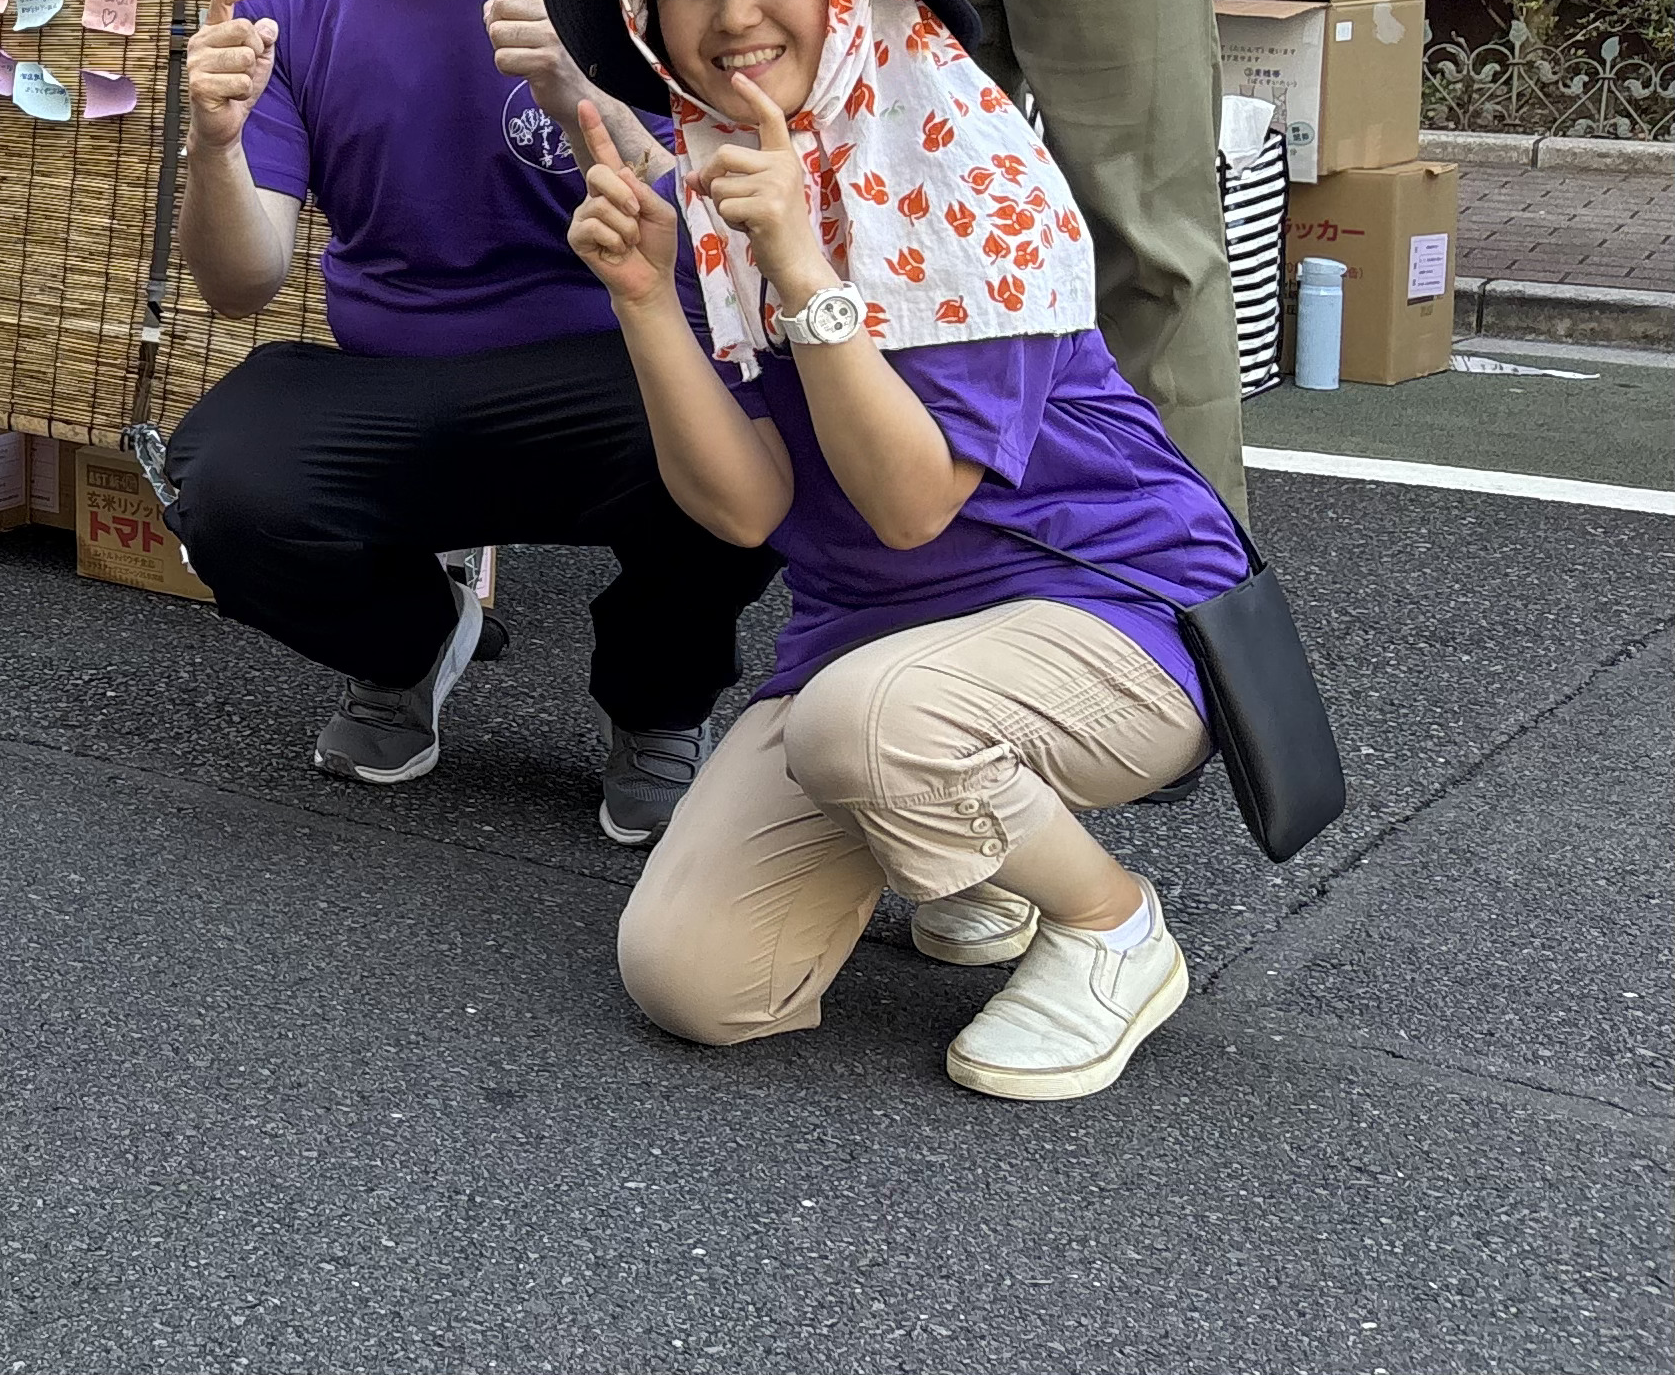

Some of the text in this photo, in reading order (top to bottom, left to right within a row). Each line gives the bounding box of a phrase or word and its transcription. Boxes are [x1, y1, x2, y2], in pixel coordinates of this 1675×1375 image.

[87, 491, 164, 521] 玄米リゾット
[90, 510, 164, 553] トマト
